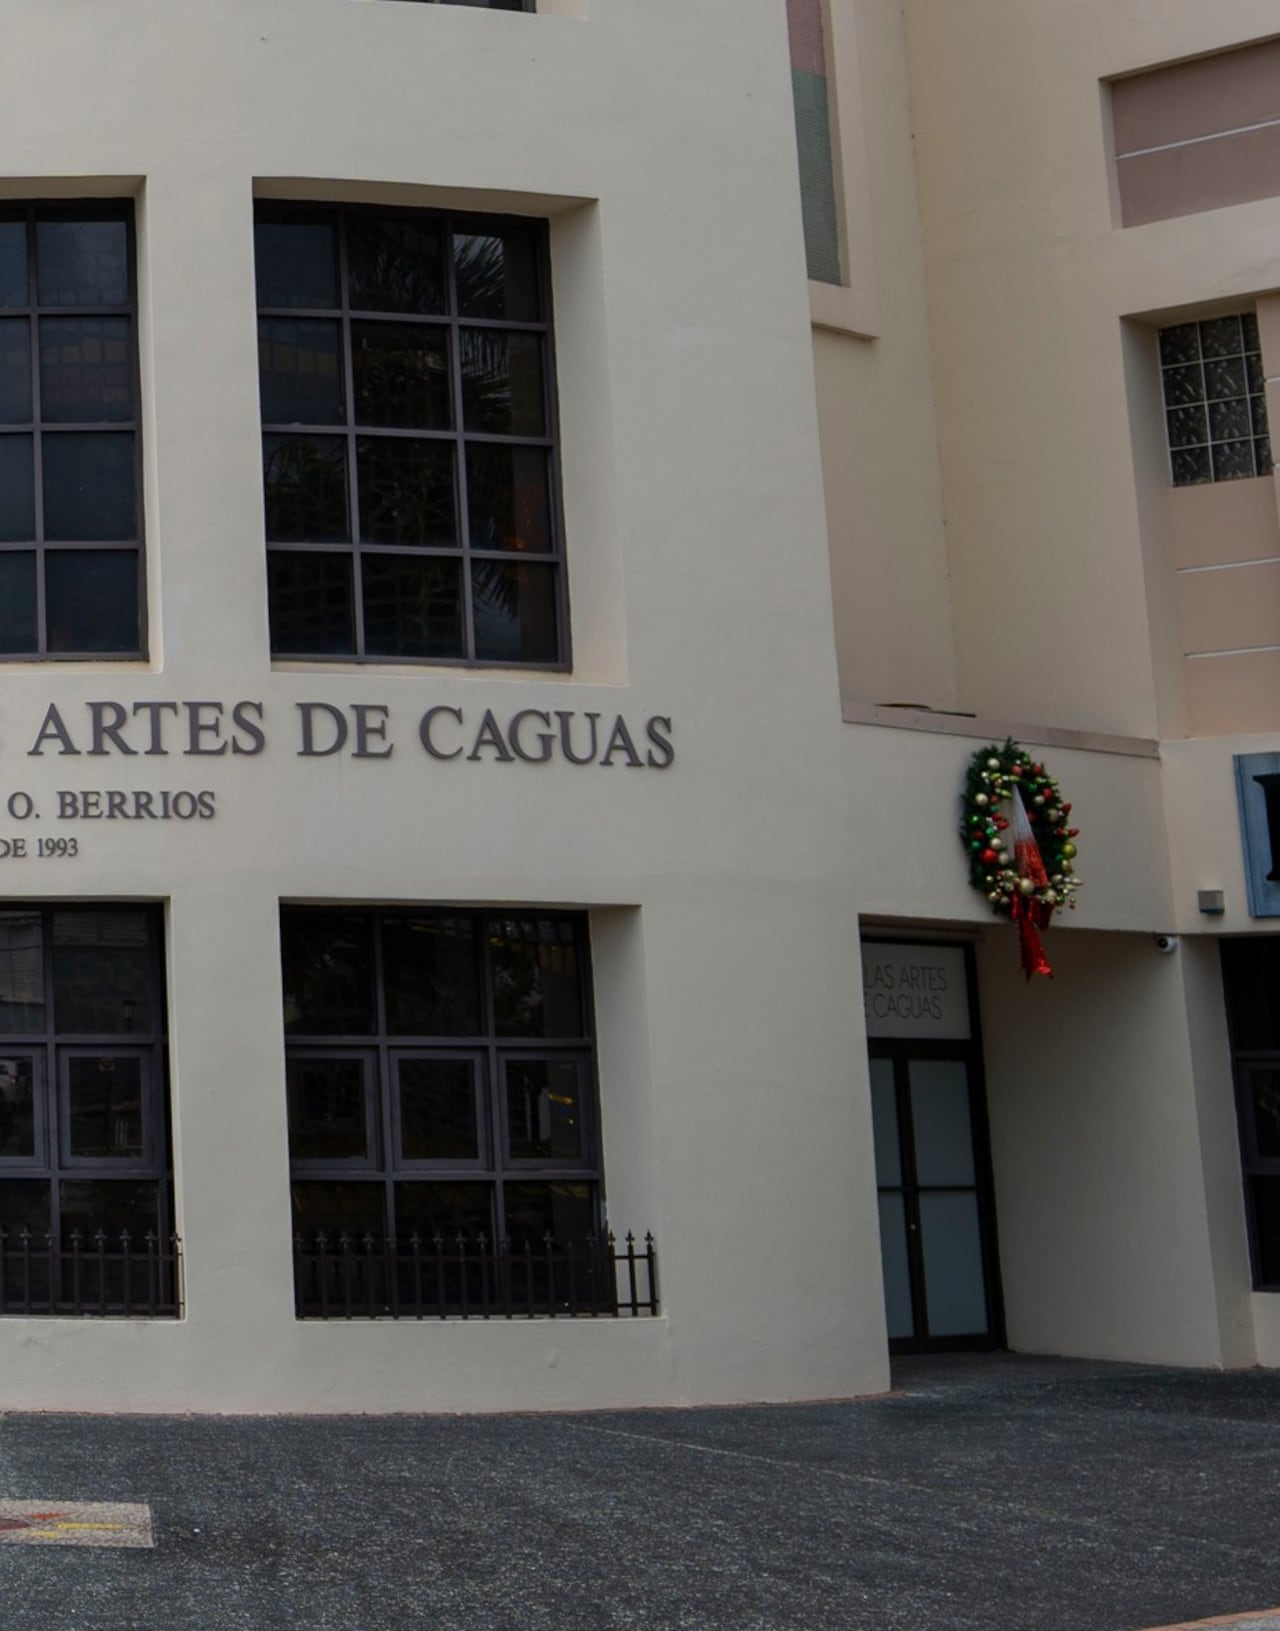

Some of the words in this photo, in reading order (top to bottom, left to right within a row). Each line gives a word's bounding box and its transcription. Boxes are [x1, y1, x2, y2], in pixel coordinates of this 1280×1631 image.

[27, 700, 266, 757] ARTES
[295, 702, 395, 760] DE
[419, 705, 675, 771] CAGUAS
[7, 791, 41, 820] O.
[56, 791, 217, 821] BERRIOS
[37, 838, 79, 858] 1993
[898, 965, 948, 992] ARTES
[873, 993, 942, 1020] CAGUAS
